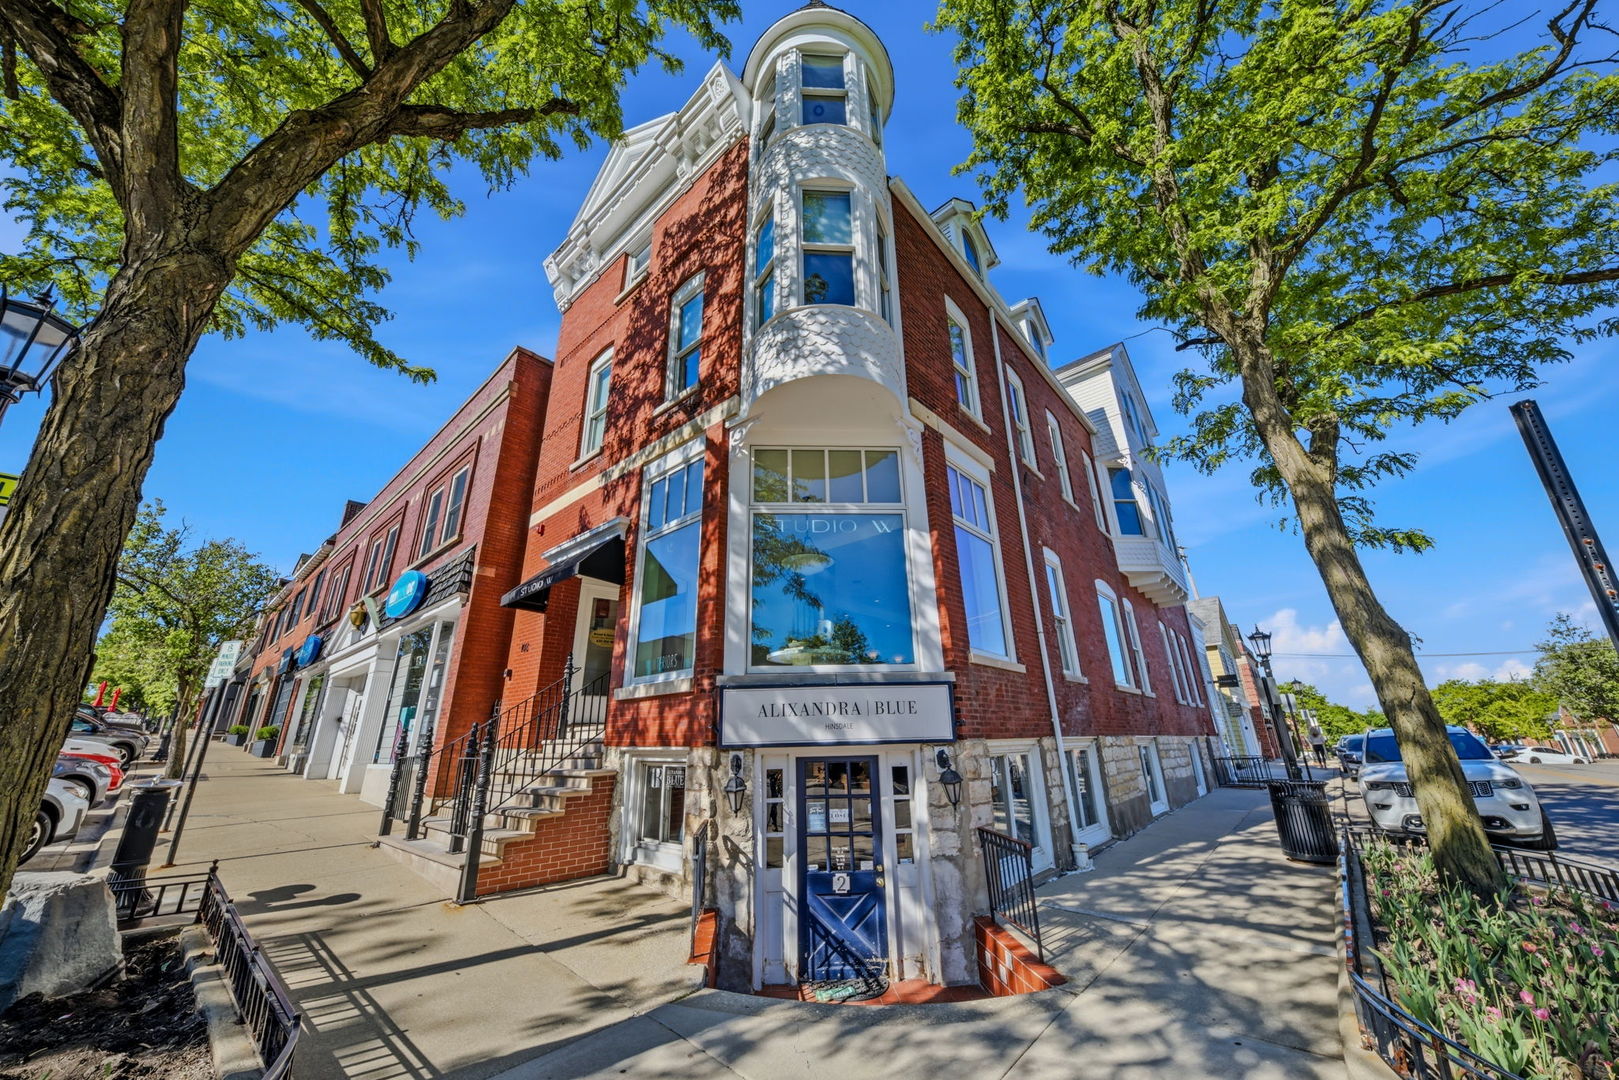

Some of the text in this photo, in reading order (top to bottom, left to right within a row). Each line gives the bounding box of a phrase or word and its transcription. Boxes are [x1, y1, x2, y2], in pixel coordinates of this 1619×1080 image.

[758, 519, 894, 533] STUDIO W
[520, 576, 554, 597] STUDIO W
[758, 700, 918, 718] ALIXANDRA BLUE
[824, 722, 854, 730] HINSDALE
[836, 875, 847, 892] 2
